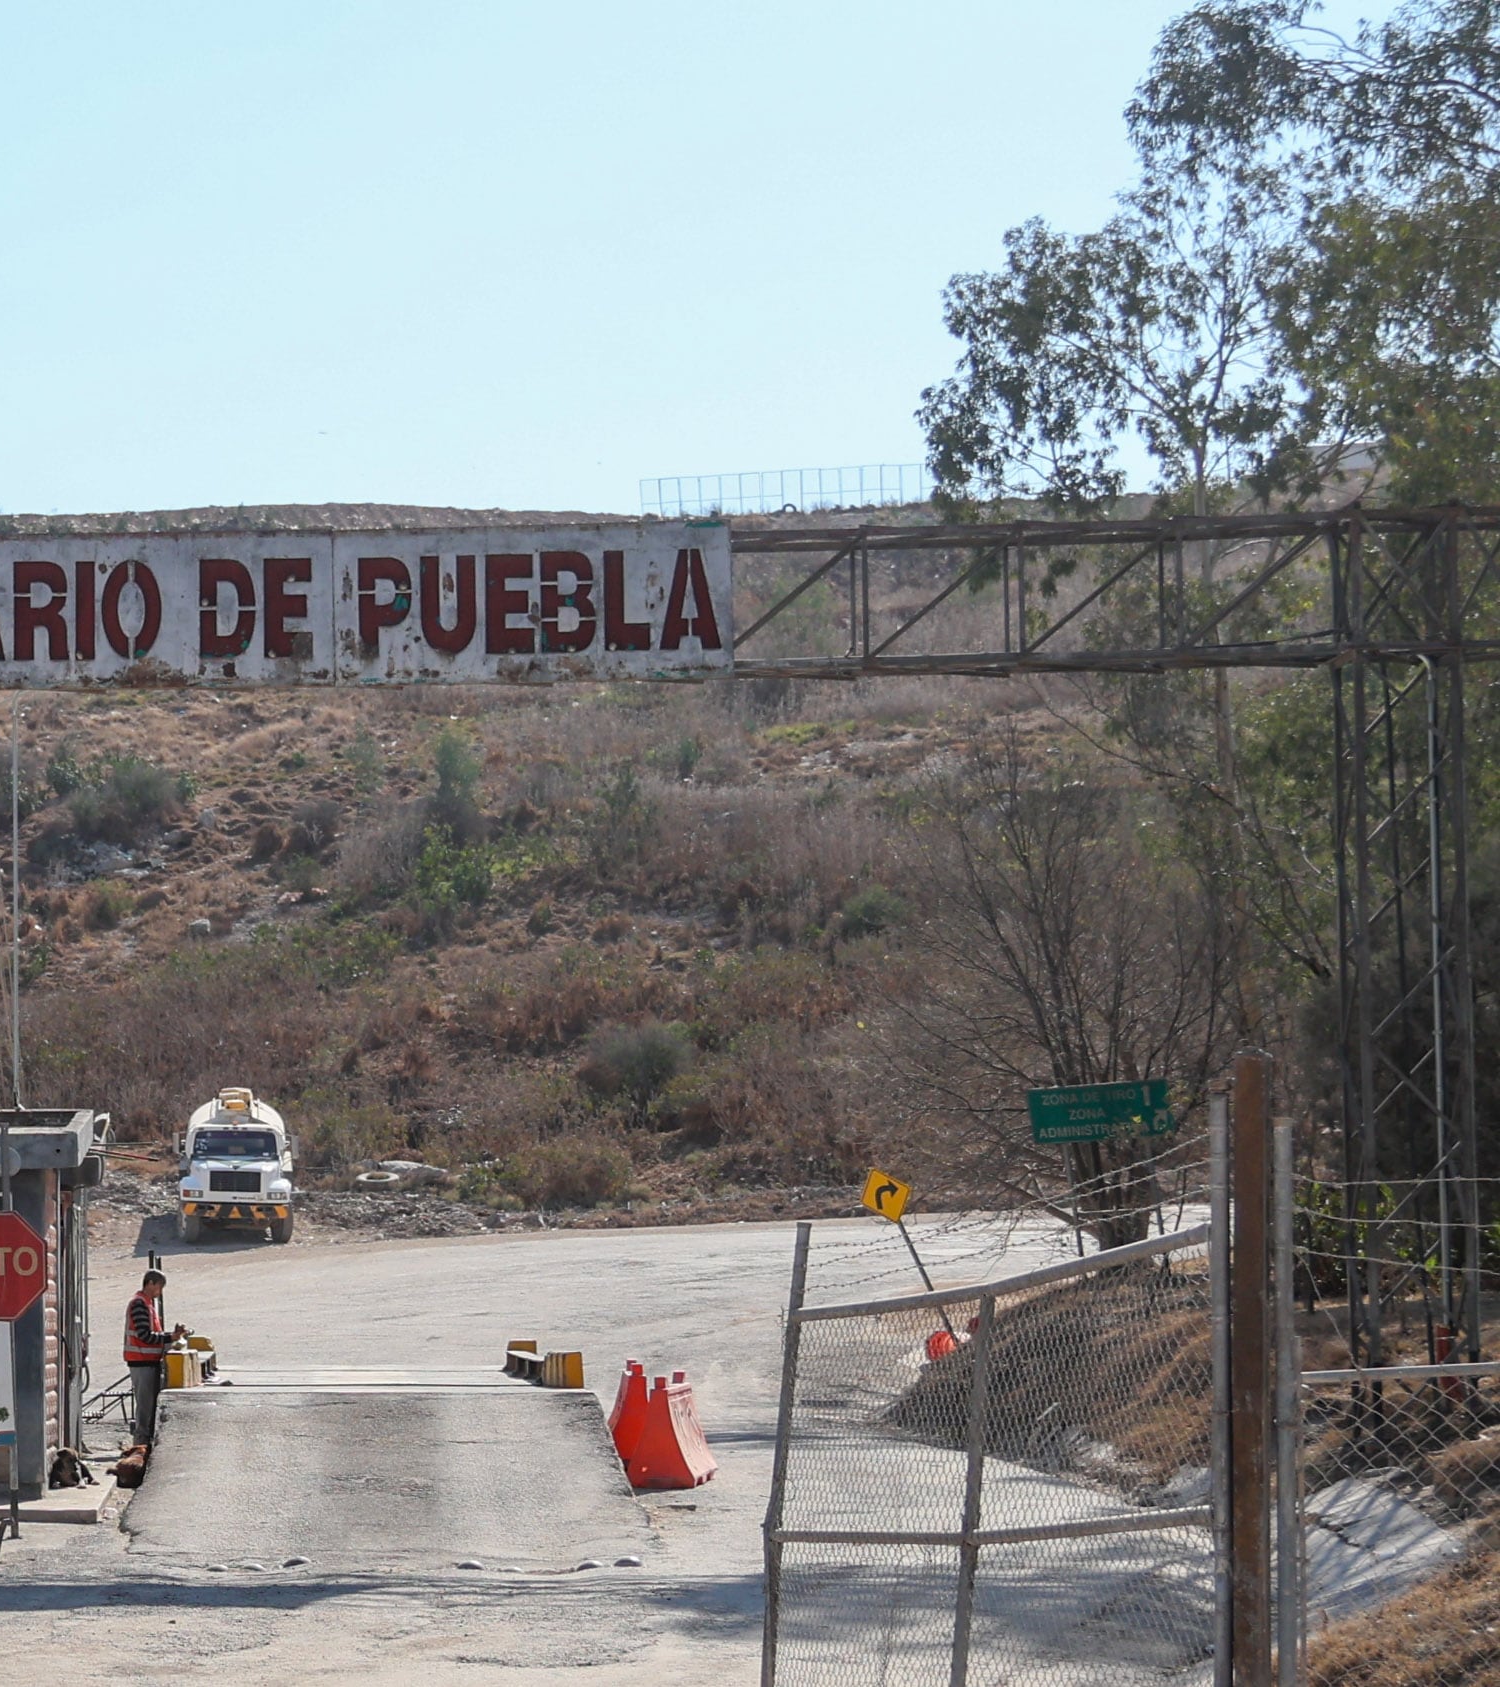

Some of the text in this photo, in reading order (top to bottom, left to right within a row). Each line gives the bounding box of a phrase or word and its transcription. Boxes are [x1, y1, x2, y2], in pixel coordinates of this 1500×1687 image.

[199, 557, 313, 658] DE
[357, 548, 722, 657] PUEBLA
[1041, 1094, 1078, 1106] ZONA
[1082, 1090, 1100, 1103] DE
[1069, 1108, 1106, 1120] ZONA
